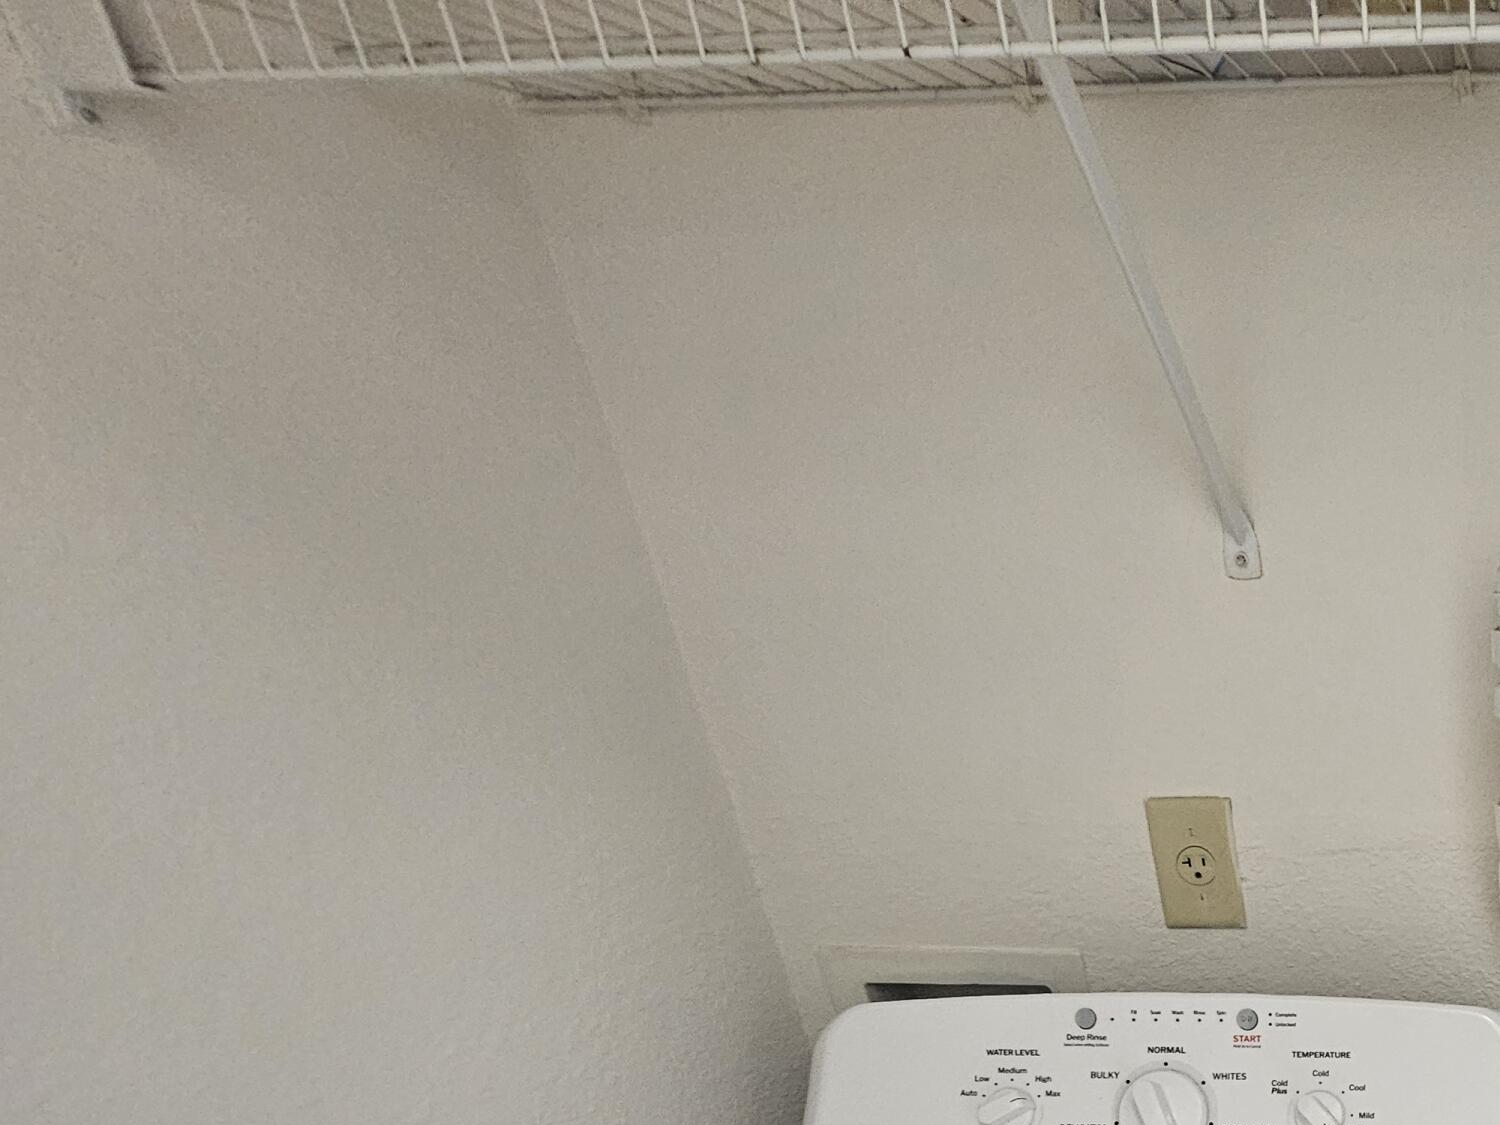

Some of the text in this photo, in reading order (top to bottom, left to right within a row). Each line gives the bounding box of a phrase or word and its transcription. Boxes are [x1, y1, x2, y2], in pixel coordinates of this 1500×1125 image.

[1066, 1034, 1085, 1042] Deep
[1233, 1035, 1261, 1043] START
[1147, 1046, 1186, 1054] NORMAL
[1292, 1051, 1351, 1059] TEMPERATURE
[1090, 1071, 1120, 1080] BULKY
[1212, 1072, 1247, 1081] WHITES
[1312, 1069, 1330, 1077] Cold
[1035, 1075, 1052, 1083] High
[1271, 1087, 1288, 1095] Plus
[1348, 1083, 1366, 1091] Cool
[1358, 1111, 1375, 1119] Mild
